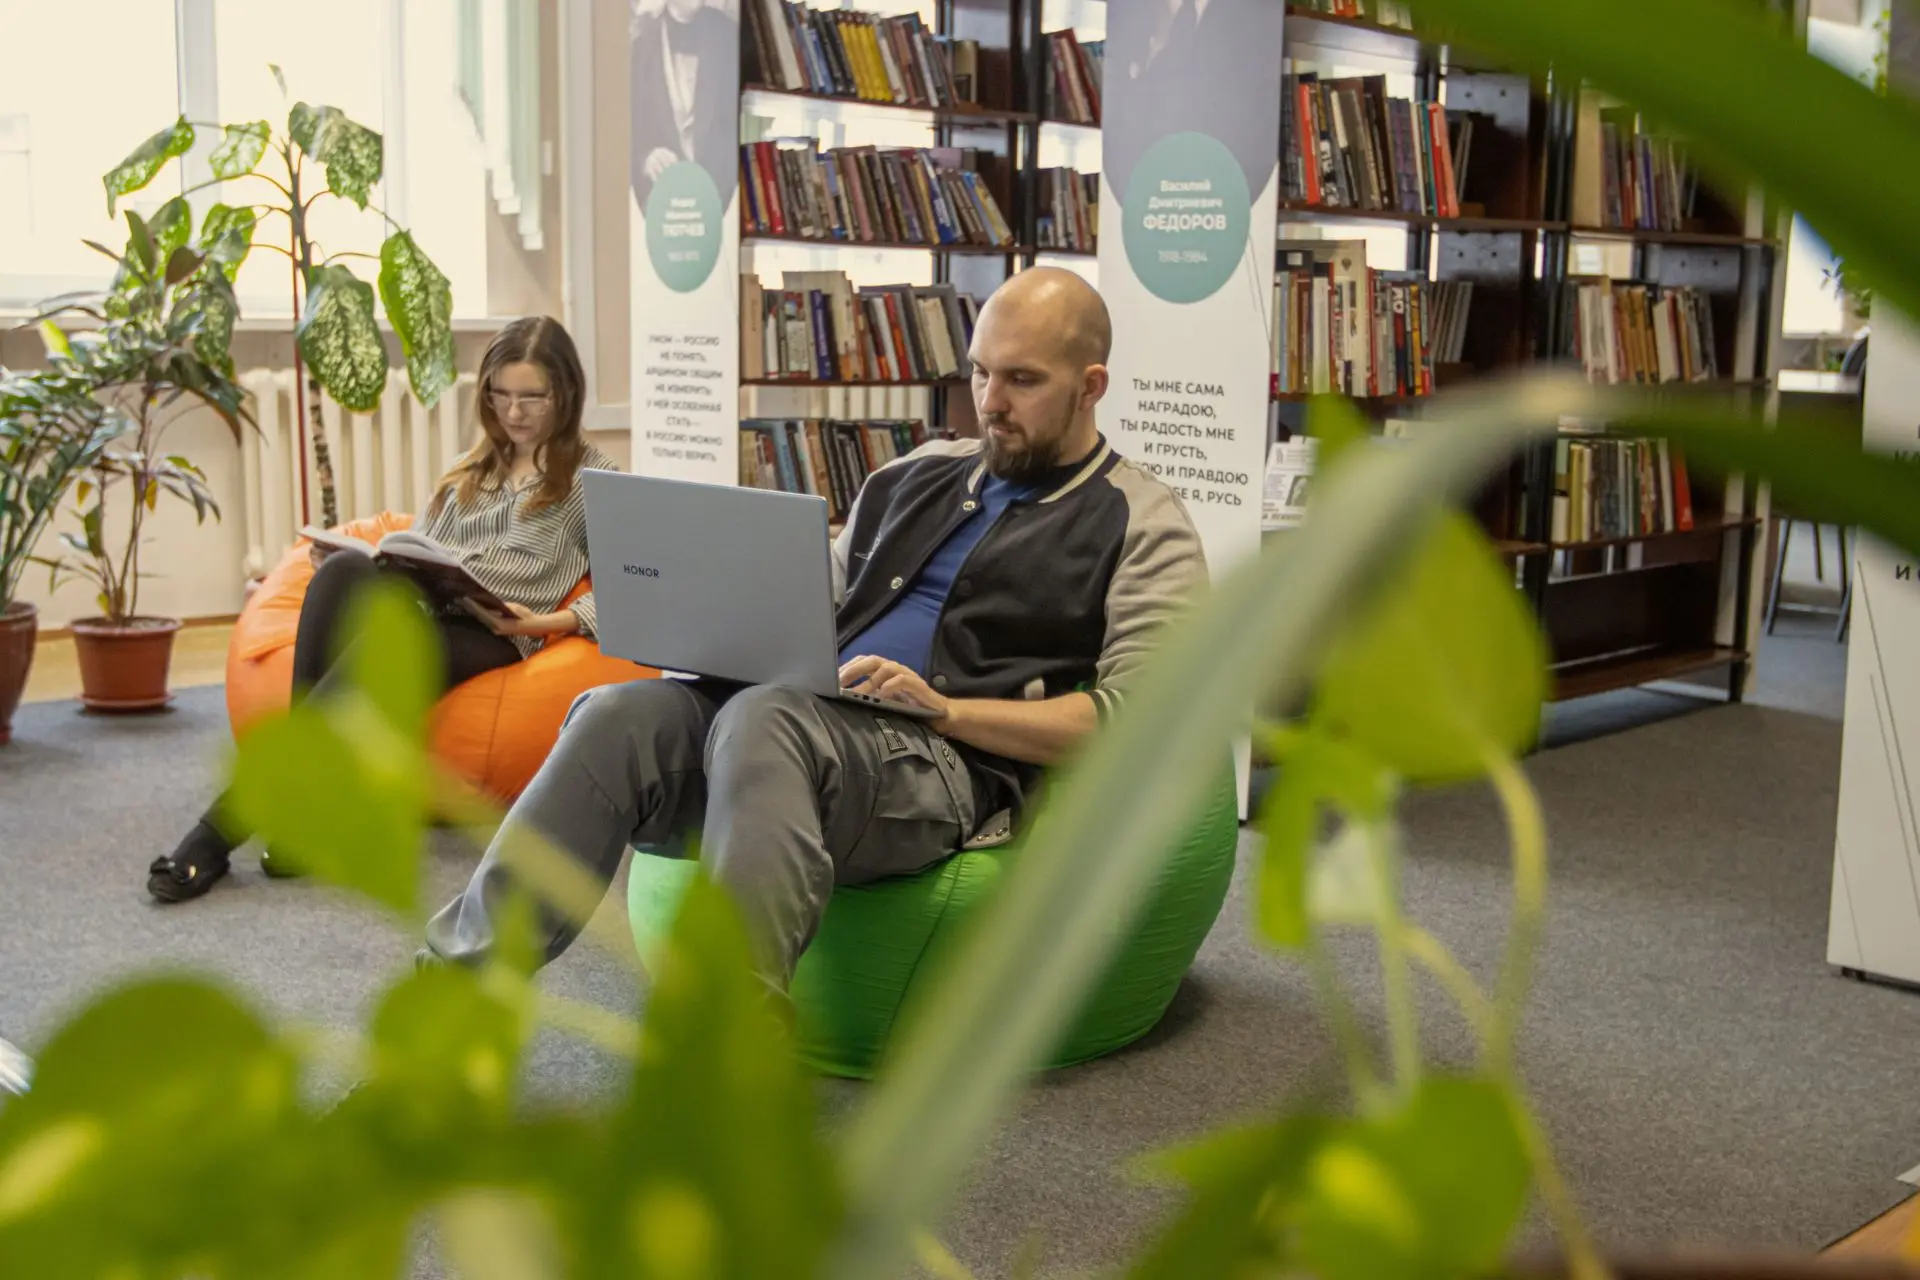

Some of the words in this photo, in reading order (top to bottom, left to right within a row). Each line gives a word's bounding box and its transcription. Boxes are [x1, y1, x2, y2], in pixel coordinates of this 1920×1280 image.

[1143, 213, 1227, 232] ФЕДОРОВ
[1132, 378, 1151, 391] ТЫ
[1154, 380, 1183, 394] МНЕ
[1185, 382, 1225, 397] САМА
[1137, 400, 1217, 420] НАГРАДОЮ,
[1120, 418, 1139, 432] ТЫ
[1141, 420, 1203, 438] РАДОСТЬ
[1206, 426, 1236, 441] МНЕ
[1144, 442, 1154, 454] И
[1166, 465, 1176, 477] И
[1179, 466, 1249, 486] ПРАВДОЮ
[1207, 490, 1242, 506] РУСЬ
[623, 564, 660, 578] HONOR
